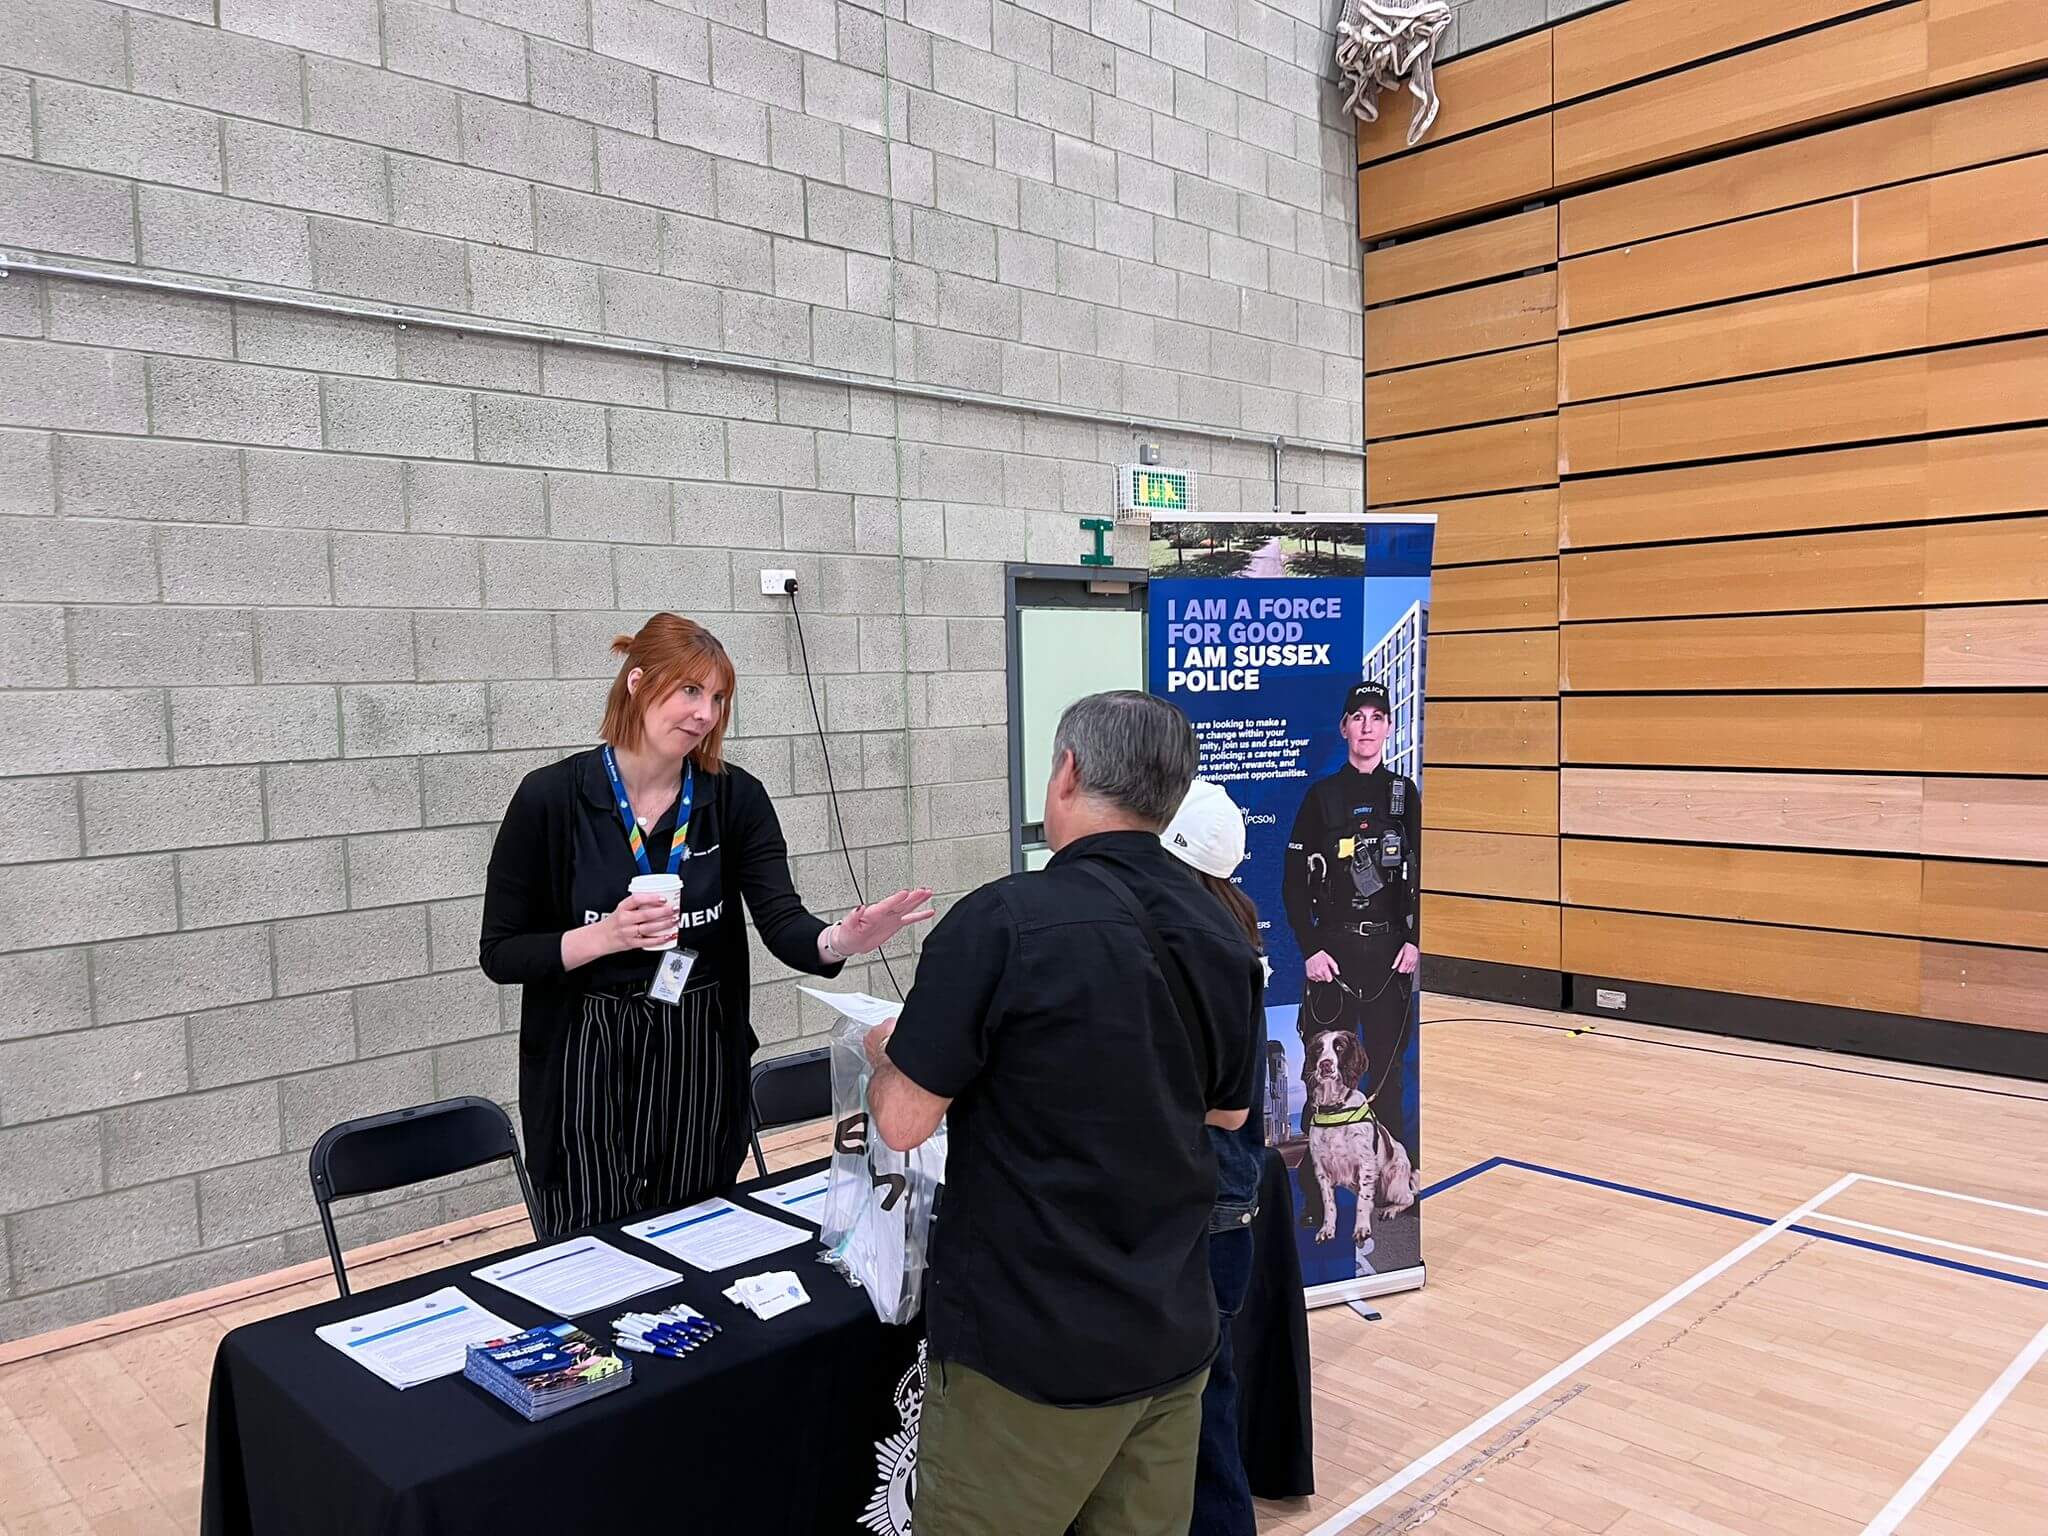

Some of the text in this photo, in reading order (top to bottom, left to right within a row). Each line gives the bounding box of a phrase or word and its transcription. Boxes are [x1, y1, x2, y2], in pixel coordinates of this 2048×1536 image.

[1168, 598, 1341, 620] I AM A FORCE
[1168, 622, 1302, 644] FOR GOOD
[1168, 644, 1330, 668] I AM SUSSEX
[1168, 669, 1259, 692] POLICE
[1197, 721, 1210, 729] are
[1213, 720, 1244, 729] looking
[1246, 719, 1254, 727] to
[1256, 718, 1279, 726] make
[1206, 730, 1236, 740] change
[1239, 729, 1264, 738] within
[1266, 730, 1285, 738] your
[1222, 741, 1238, 751] join
[1290, 739, 1309, 748] your
[1210, 752, 1245, 761] policing;
[1210, 762, 1240, 771] variety,
[1242, 760, 1277, 769] rewards,
[1279, 759, 1295, 767] and
[1196, 769, 1308, 782] development opportunities.
[1245, 814, 1276, 826] (PCSOs)
